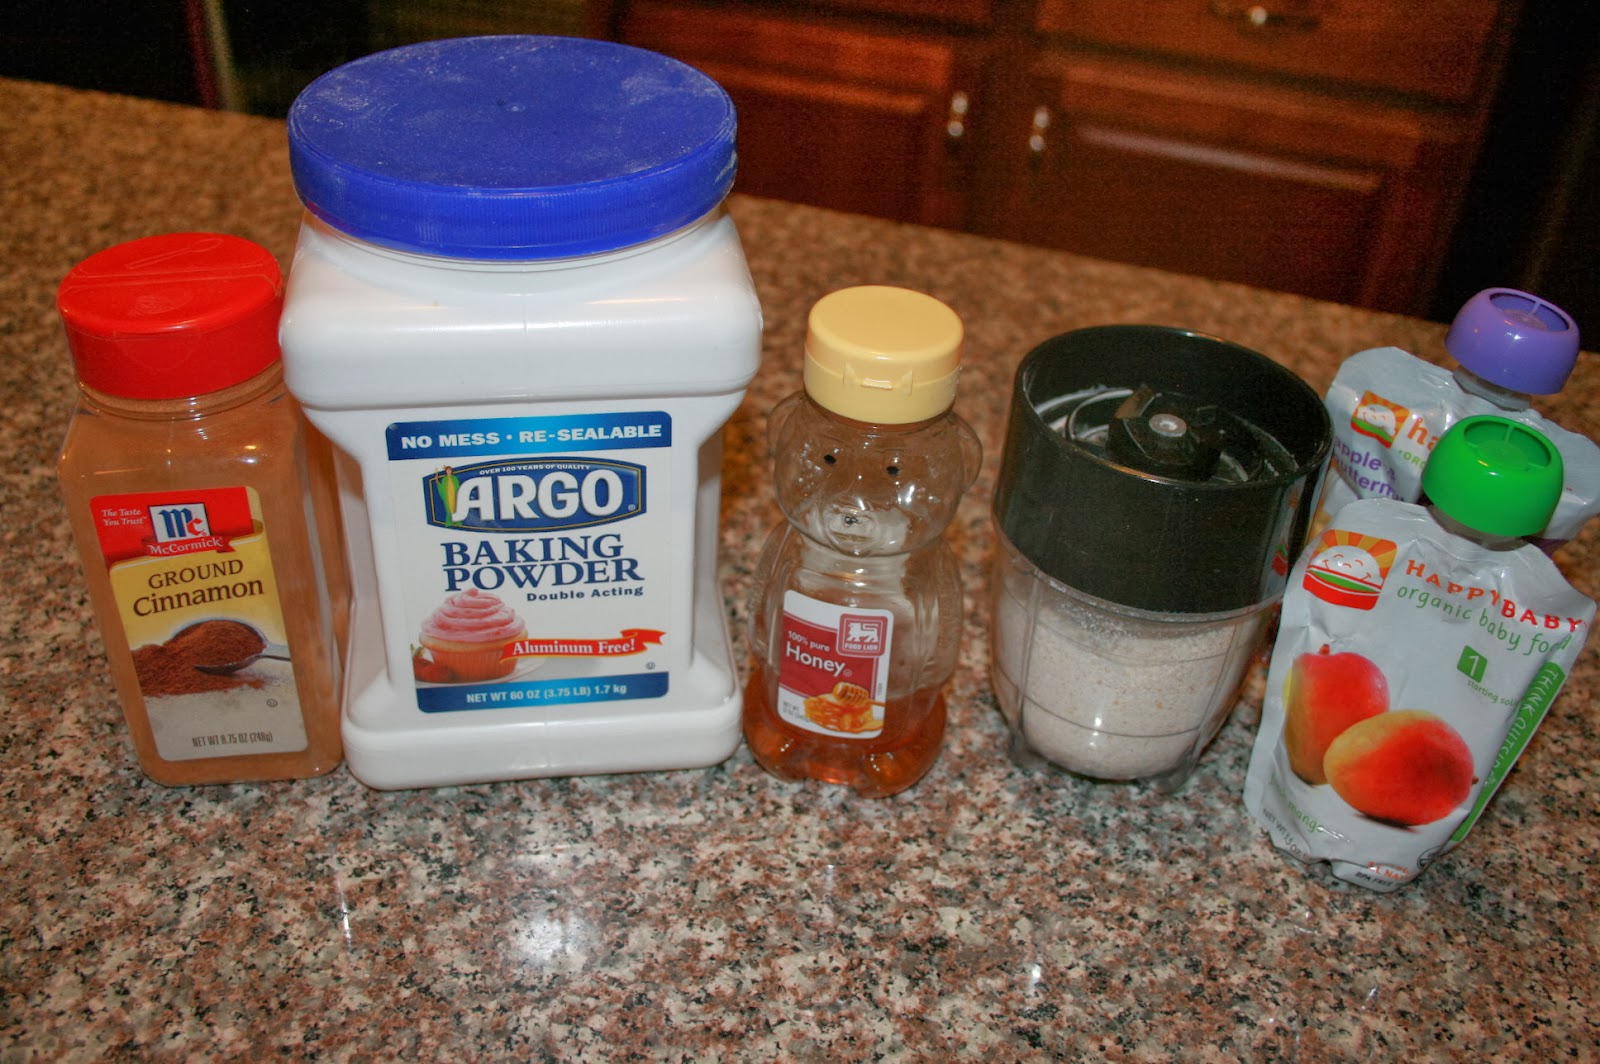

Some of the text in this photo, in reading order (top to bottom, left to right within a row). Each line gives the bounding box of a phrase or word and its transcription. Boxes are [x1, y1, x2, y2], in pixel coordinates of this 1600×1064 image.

[401, 424, 662, 449] NO MESS RE-SEALABLE
[480, 467, 500, 475] OVER
[452, 469, 623, 522] ARGO
[102, 508, 141, 517] The Taste
[103, 518, 120, 526] You
[147, 538, 221, 555] McCormick
[440, 533, 625, 567] BAKING
[148, 559, 244, 589] GROUND
[442, 557, 645, 592] POWDER
[133, 579, 264, 617] Cinnamon
[527, 586, 645, 602] Double Acting
[1397, 586, 1472, 621] organic
[1478, 608, 1521, 651] baby
[512, 640, 636, 656] Aluminum Free!
[788, 630, 831, 653] 100% pure
[785, 641, 845, 677] Honey
[1469, 655, 1480, 677] 1
[466, 684, 627, 704] NET WT 60 OZ (3.75 LB) 1.7 kg
[1467, 680, 1499, 704] starting
[1520, 668, 1559, 717] THINK
[192, 731, 273, 748] NET WT 8.75 OZ (248g)
